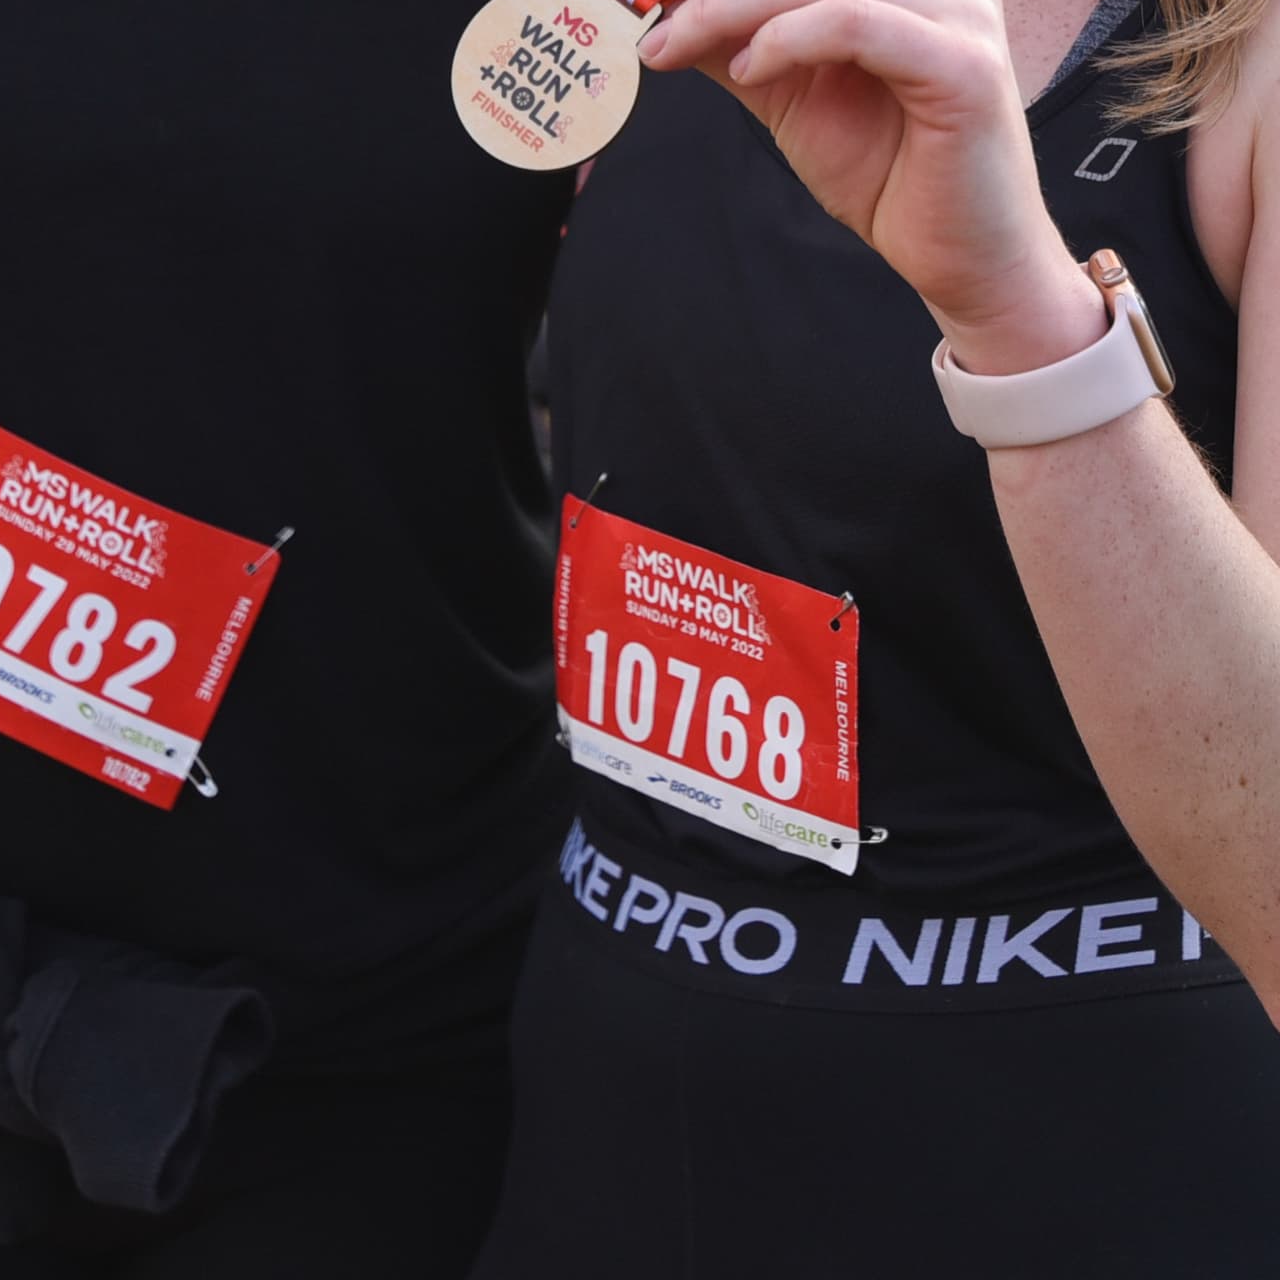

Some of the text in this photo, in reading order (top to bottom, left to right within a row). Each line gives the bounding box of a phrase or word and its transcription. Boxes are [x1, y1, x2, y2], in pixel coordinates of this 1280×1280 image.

[520, 15, 602, 88] WALK
[553, 5, 599, 47] MS
[480, 64, 558, 139] +ROLL
[508, 47, 572, 103] RUN
[471, 90, 545, 153] FINISHER
[75, 546, 111, 569] MAY
[111, 563, 151, 589] 2022
[557, 554, 571, 668] MELBOURNE
[626, 599, 764, 661] SUNDAY 29 MAY 2022
[196, 597, 252, 702] MELBOURNE
[585, 628, 806, 801] 10768
[834, 660, 851, 782] MELBOURNE
[669, 779, 723, 811] BROOKS
[758, 802, 829, 850] lifecare
[613, 874, 798, 977] PRO
[840, 896, 1159, 986] NIKE
